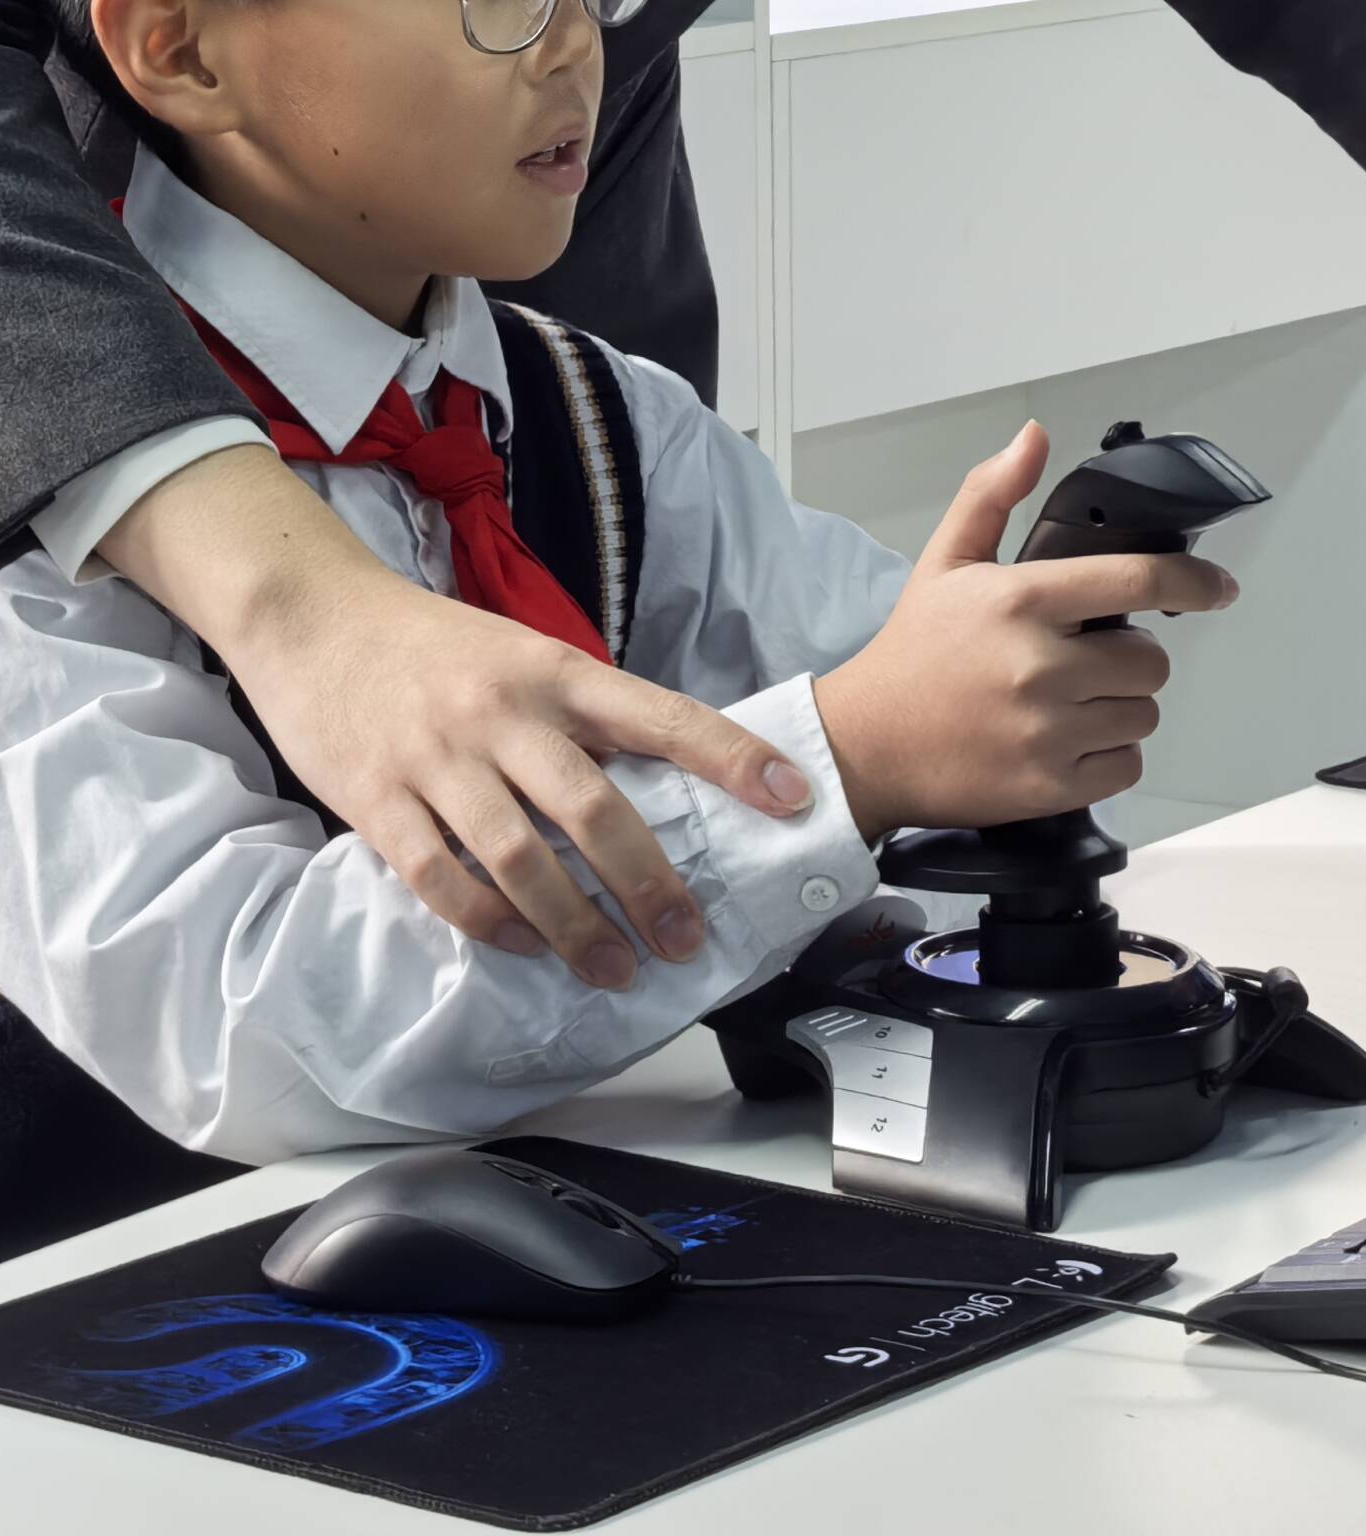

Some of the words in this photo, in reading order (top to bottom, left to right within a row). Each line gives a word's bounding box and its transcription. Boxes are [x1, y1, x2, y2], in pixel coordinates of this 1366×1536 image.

[874, 1025, 892, 1039] 10
[871, 1066, 888, 1080] 11
[871, 1117, 888, 1133] 12
[897, 1276, 1064, 1339] Lgitech
